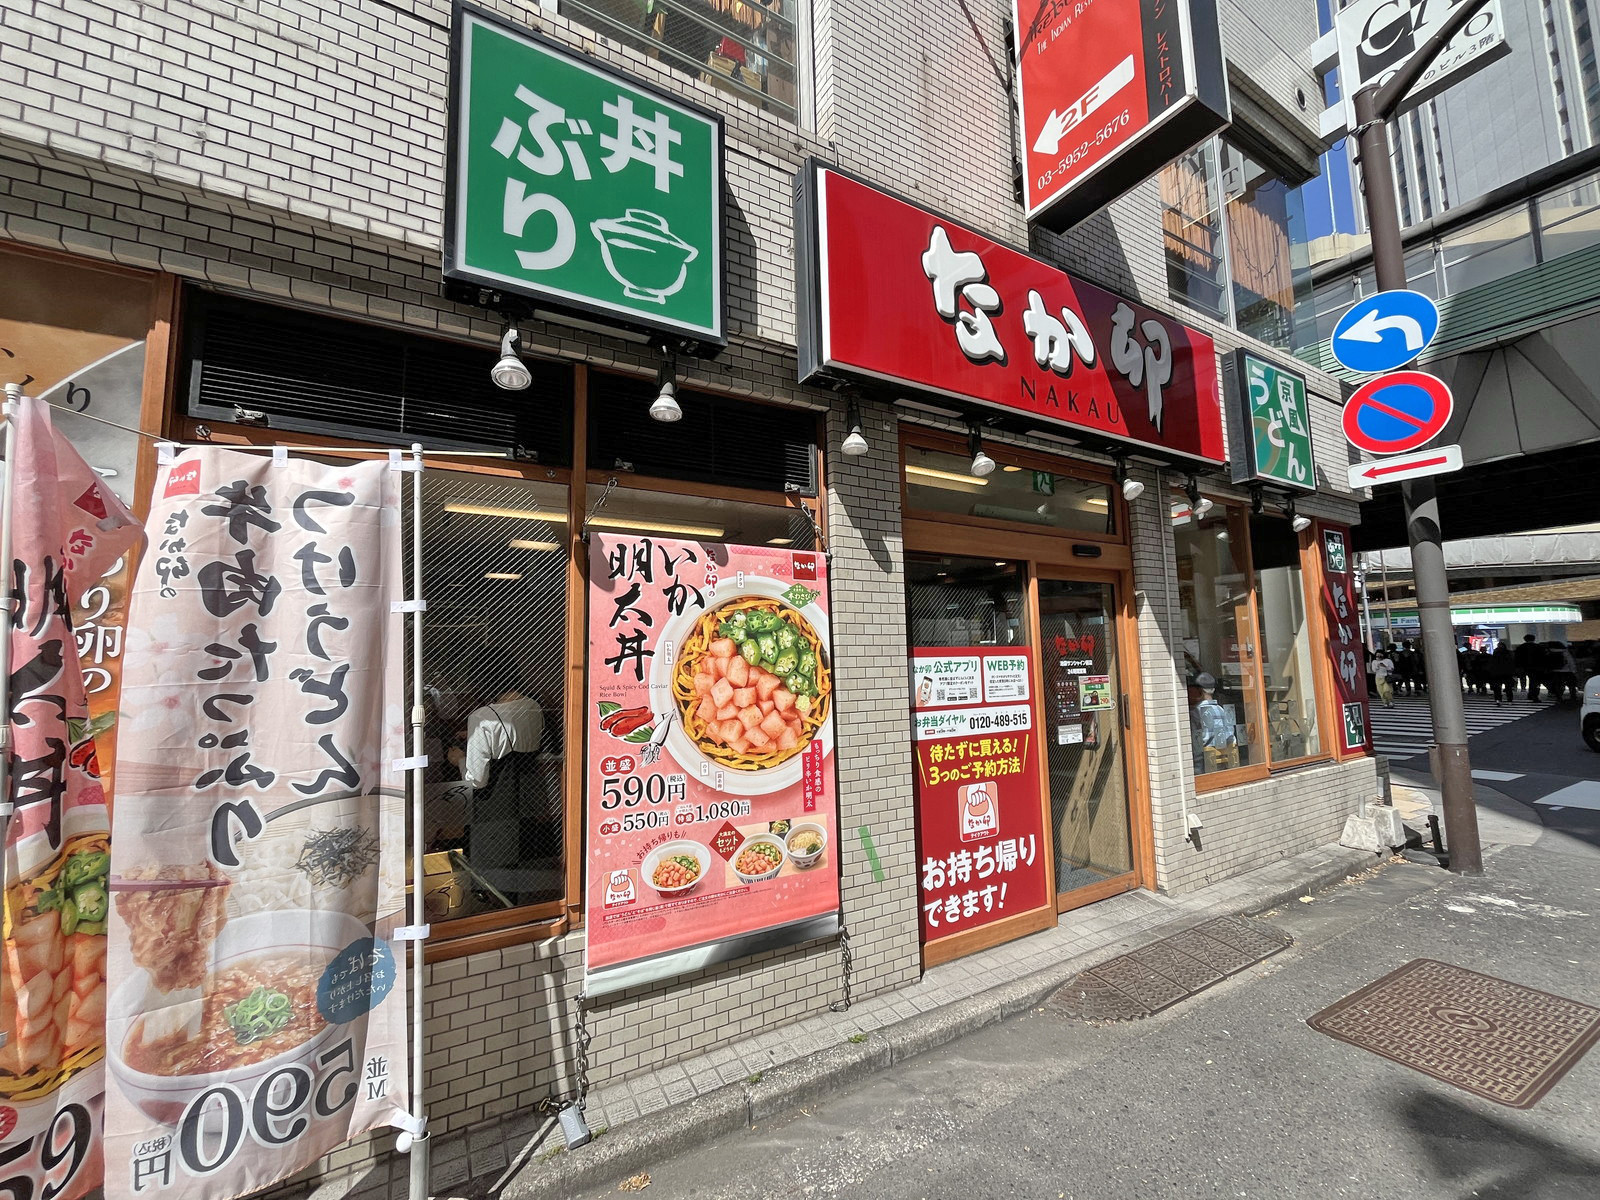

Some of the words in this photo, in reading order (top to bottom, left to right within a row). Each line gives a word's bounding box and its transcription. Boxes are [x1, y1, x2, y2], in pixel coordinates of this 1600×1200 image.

[1051, 16, 1072, 42] INDIAN
[1156, 30, 1172, 105] レストロバー
[1060, 86, 1100, 135] 2F
[1037, 109, 1130, 190] 03-5952-5676
[922, 223, 1174, 435] なか卯
[1020, 375, 1120, 425] NAKAU
[1250, 365, 1306, 482] うどん
[658, 544, 706, 615] いか
[705, 548, 718, 597] なか卯の
[794, 560, 815, 572] なか卯
[605, 538, 655, 681] 明太丼
[1332, 581, 1357, 694] なか卯
[622, 683, 637, 691] Spicy
[933, 660, 978, 673] 公式アプリ
[986, 659, 1025, 671] WEB予約
[914, 713, 967, 728] お弁当ダイヤル
[970, 713, 1027, 730] 0120-489-515
[605, 758, 632, 772] 並盛
[814, 742, 822, 793] もっちり食感の
[928, 756, 1021, 786] 3つのご予約方法
[929, 738, 1019, 764] 待たずに買える!
[636, 831, 681, 859] お持ち帰りも
[716, 836, 739, 848] セット
[967, 815, 991, 829] なか卯
[922, 834, 1036, 892] お持ち帰り
[923, 882, 1008, 928] できます!
